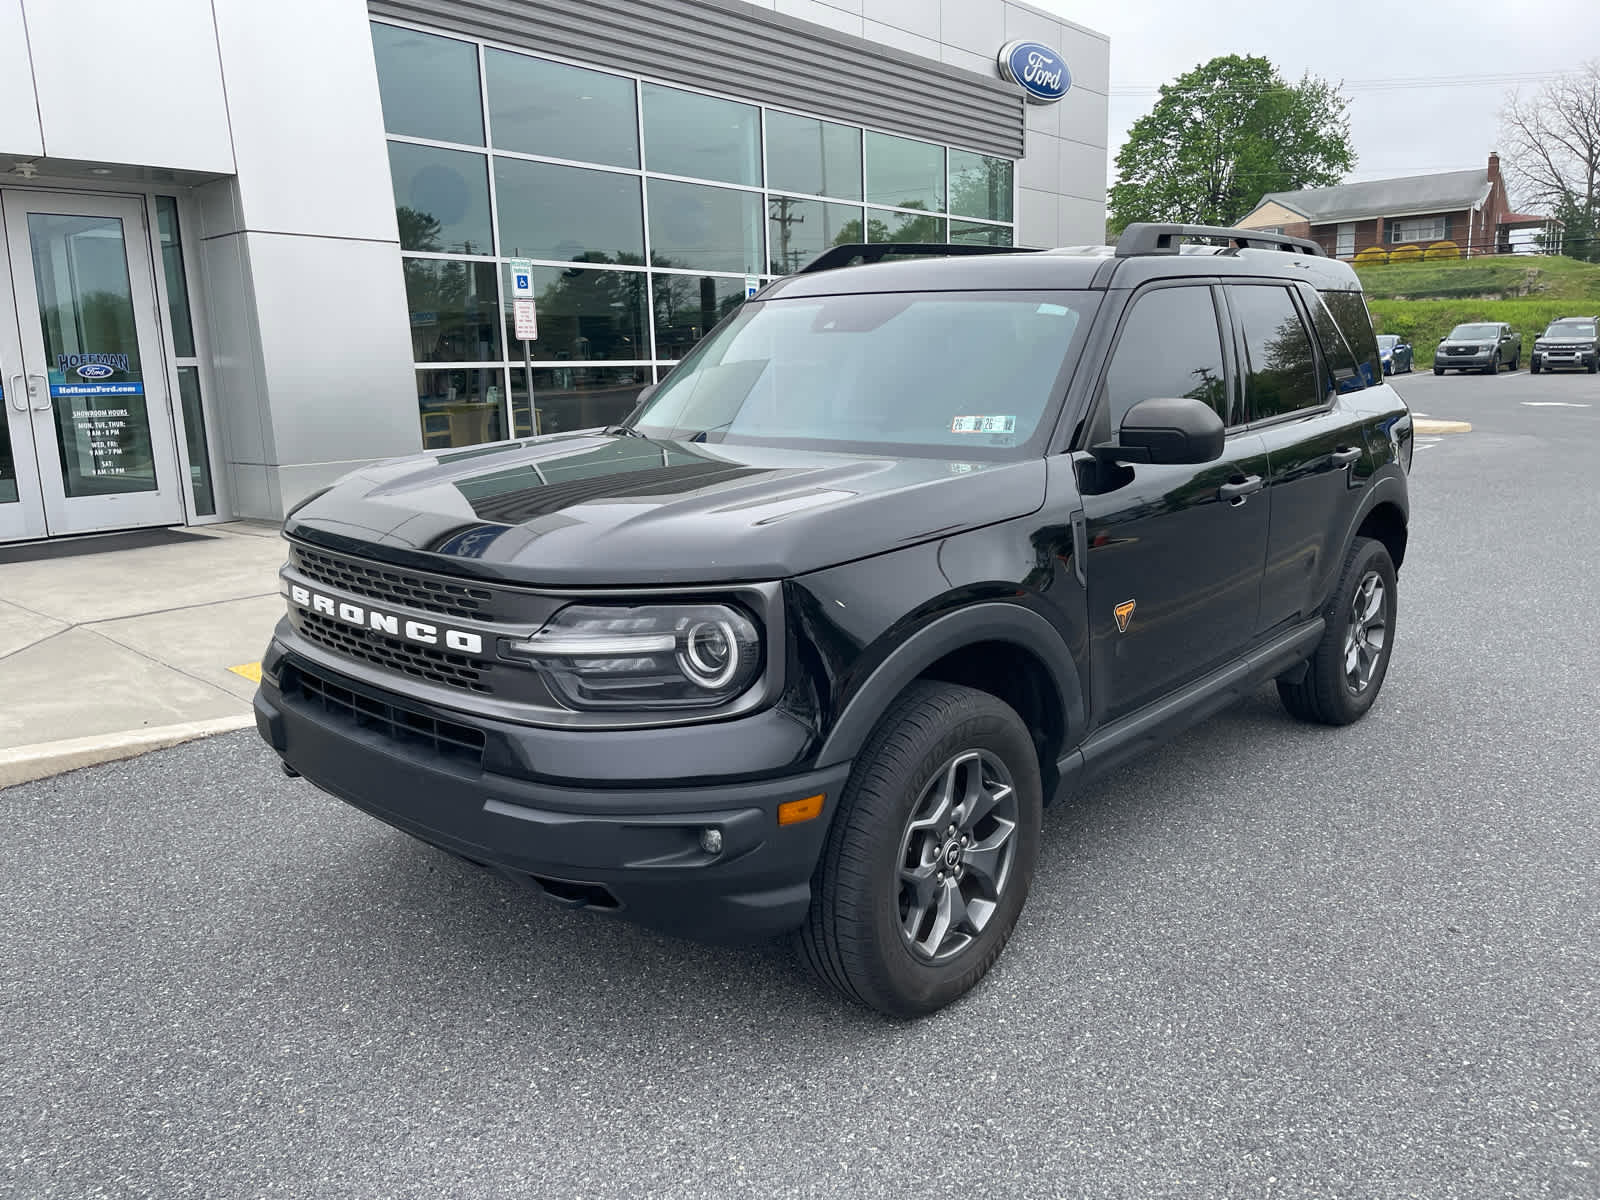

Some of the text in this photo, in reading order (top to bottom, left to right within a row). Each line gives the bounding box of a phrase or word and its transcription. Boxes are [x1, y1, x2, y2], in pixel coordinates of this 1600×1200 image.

[1024, 51, 1061, 90] Ford
[57, 352, 130, 374] HOFFMAN
[85, 366, 106, 376] Ford
[58, 385, 136, 394] HoffmanFord.com
[72, 408, 128, 418] SHOWROOM HOURS
[115, 467, 125, 475] PM
[292, 585, 482, 653] BRONCO
